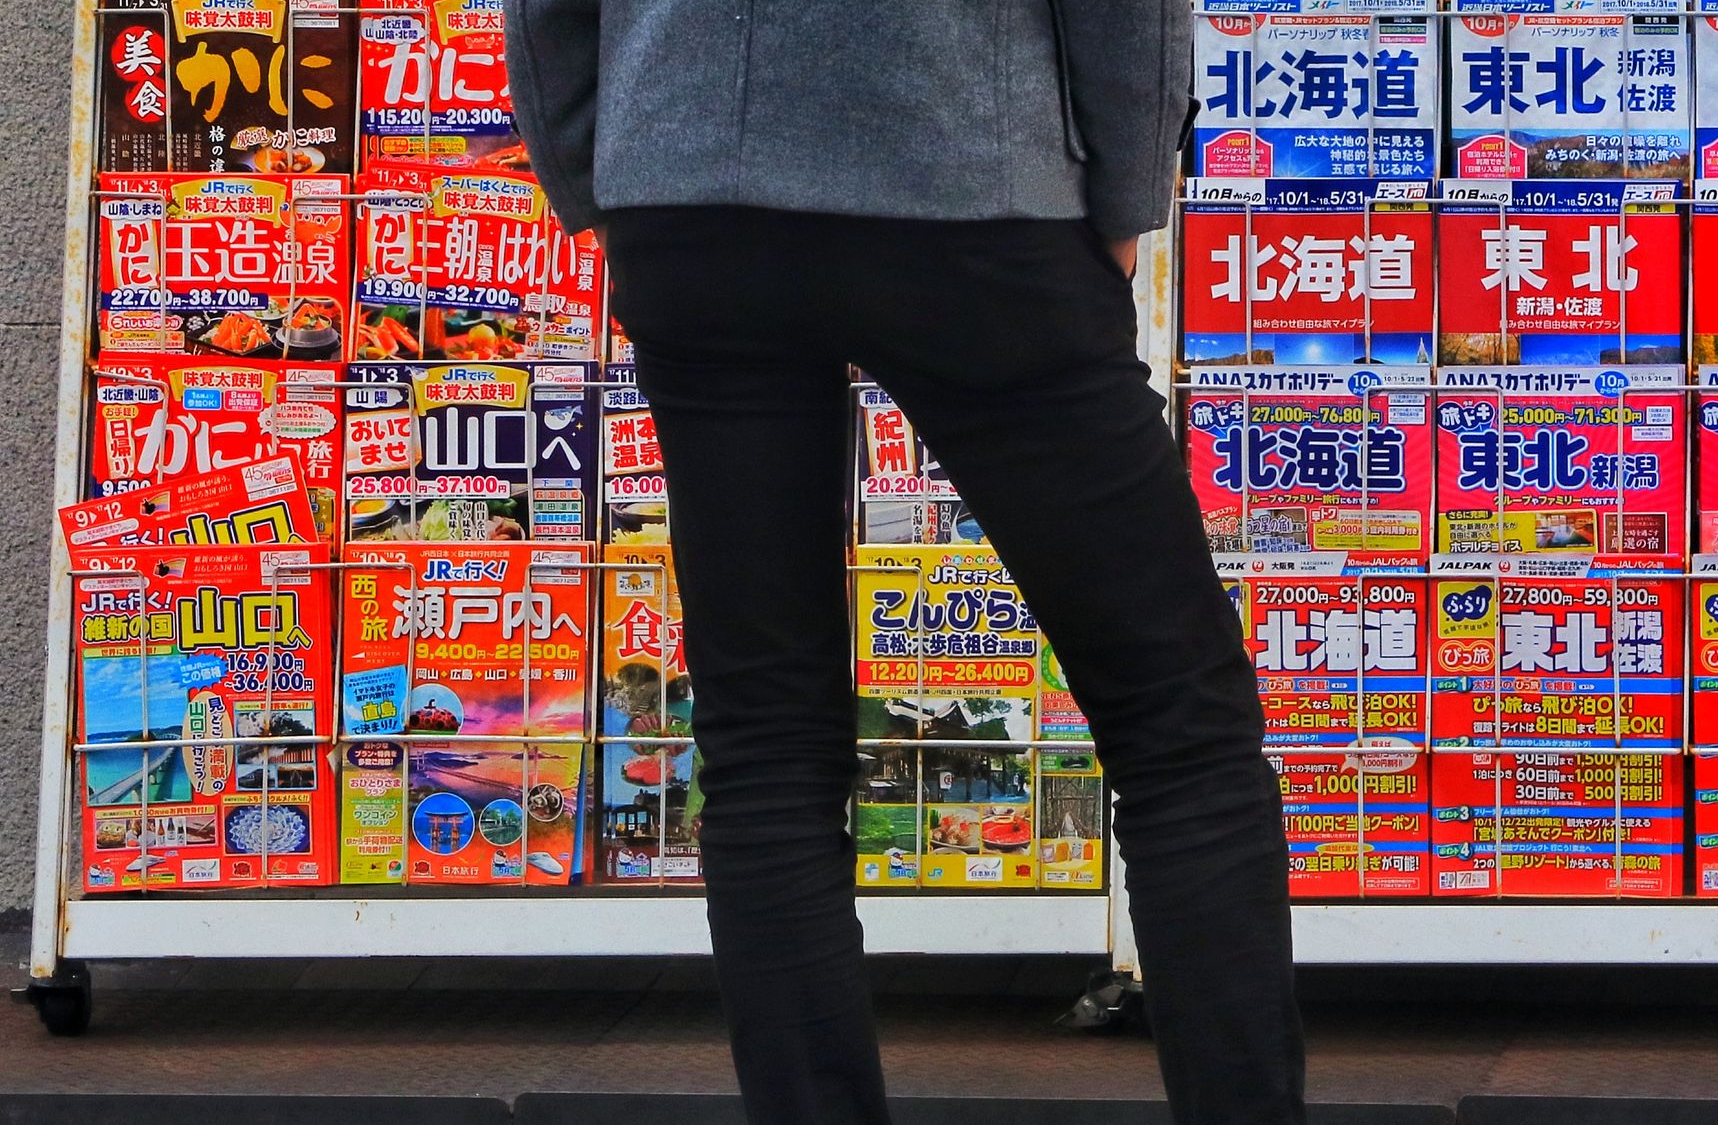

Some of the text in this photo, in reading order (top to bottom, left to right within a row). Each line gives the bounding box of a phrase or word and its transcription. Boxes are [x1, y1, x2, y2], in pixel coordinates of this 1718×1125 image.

[186, 11, 273, 28] 味覚太鼓判
[177, 42, 334, 123] かに
[1206, 49, 1419, 120] 北海道
[1462, 46, 1606, 116] 東北
[1331, 149, 1425, 163] 神秘的な景色たち
[185, 196, 273, 215] 味覚太鼓判
[201, 180, 252, 195] JRで行く
[442, 177, 534, 195] スーパーはくとで行く
[444, 194, 533, 215] 味覚太鼓判
[164, 221, 338, 285] 玉造温泉
[1211, 233, 1415, 303] 北海道
[1481, 225, 1639, 292] 東北
[183, 371, 262, 388] 味覚太鼓判
[427, 384, 513, 403] 味覚太鼓判
[442, 369, 495, 382] JRで行く
[355, 390, 387, 405] 山陽
[112, 420, 132, 478] 日帰り
[425, 408, 582, 473] 山口へ
[873, 411, 910, 475] 紀州
[1215, 426, 1402, 492] 北海道
[1438, 561, 1492, 571] JALPAK
[83, 616, 174, 642] 維新の国
[177, 588, 310, 651] 山口へ
[393, 586, 582, 642] 瀬戸内へ
[1256, 609, 1416, 672] 北海道
[228, 653, 303, 673] 16,900円
